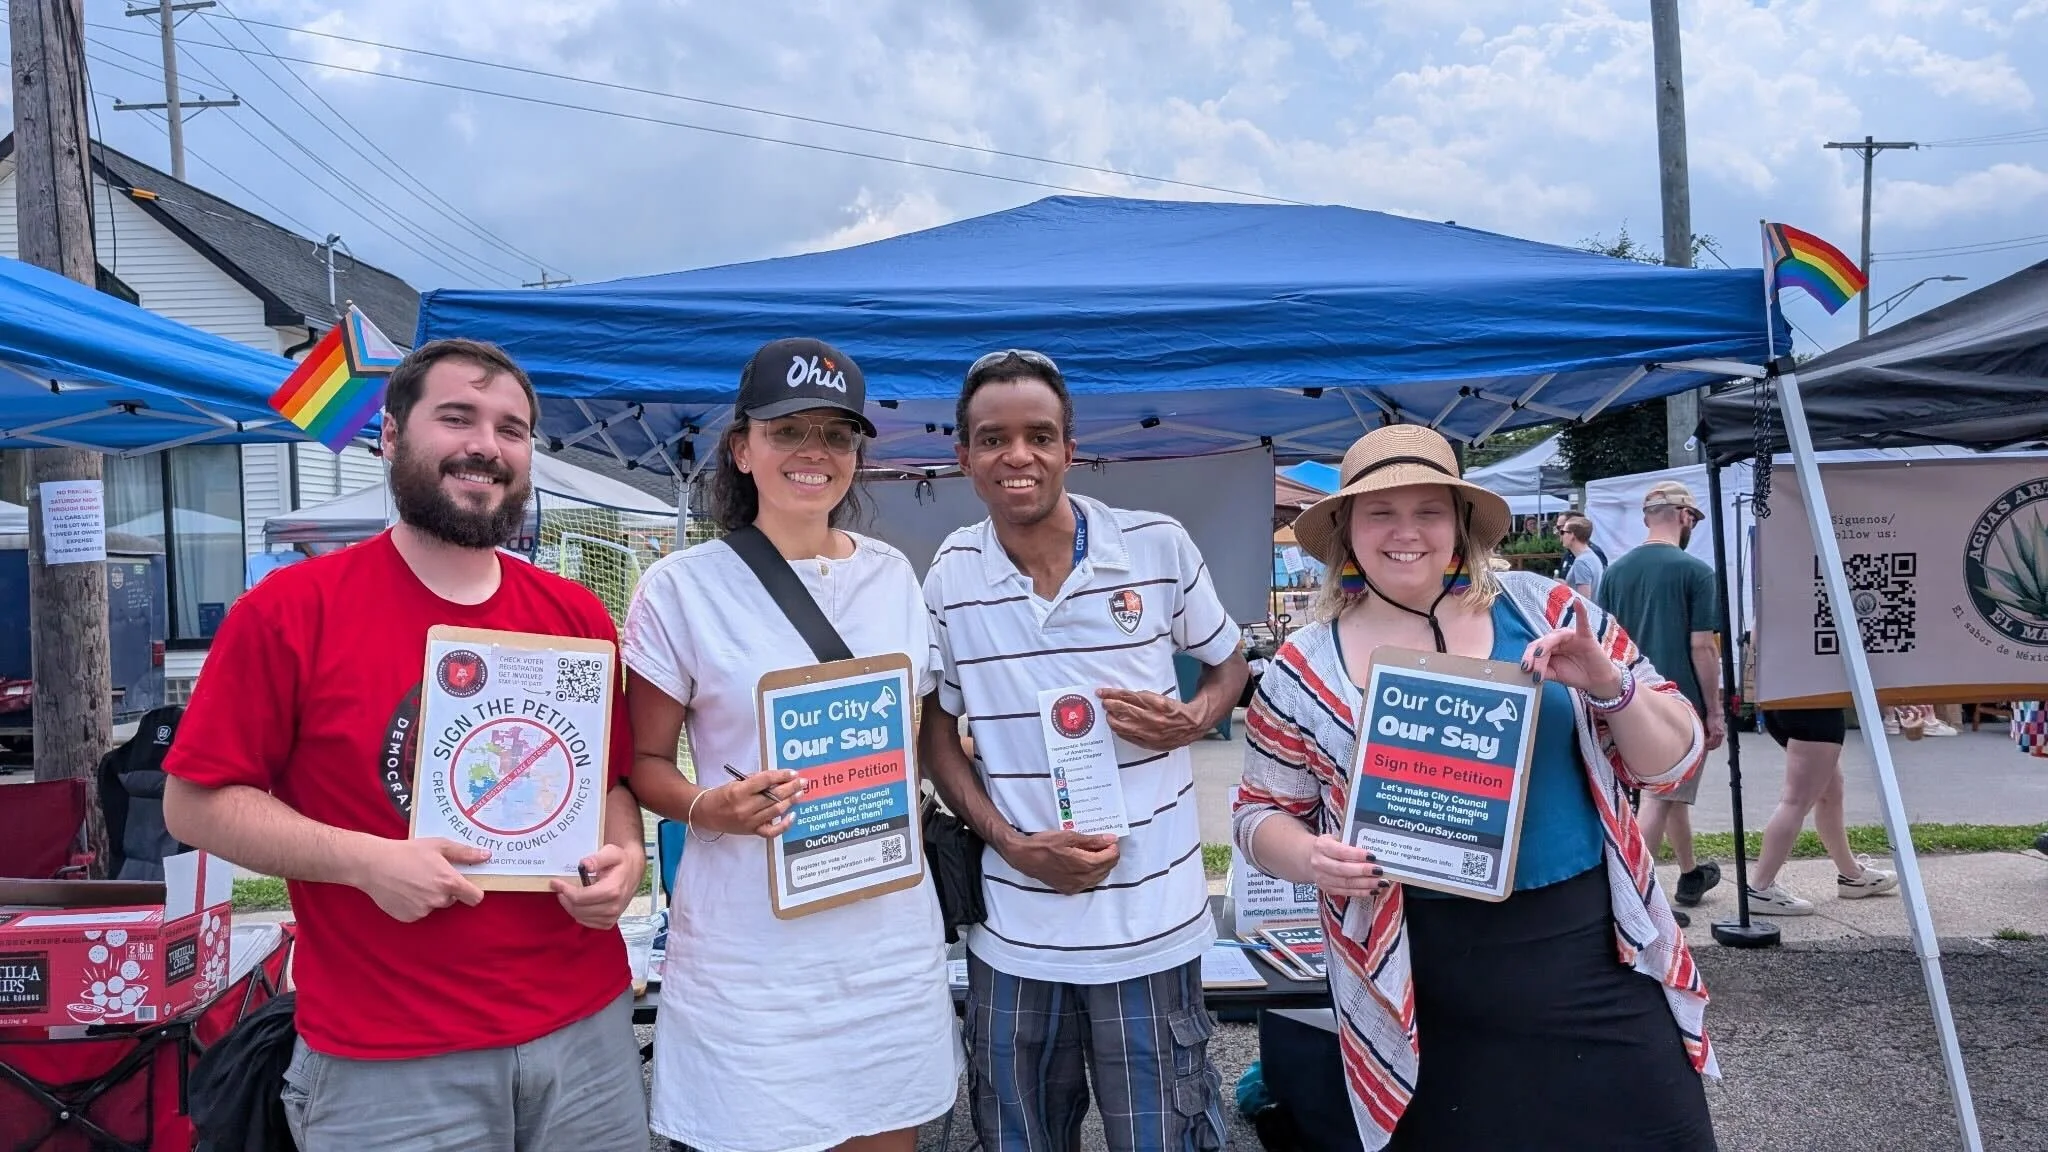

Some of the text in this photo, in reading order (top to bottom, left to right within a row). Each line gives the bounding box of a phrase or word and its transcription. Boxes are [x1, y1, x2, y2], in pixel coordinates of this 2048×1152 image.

[1835, 530, 1897, 540] ollow us:
[1969, 499, 2011, 564] AGUAS
[1952, 604, 1965, 619] El
[1964, 621, 1993, 646] sabor
[1996, 643, 2010, 656] de
[1989, 606, 2014, 633] EL
[498, 664, 544, 673] REGISTRATION
[499, 655, 521, 663] CHECK
[512, 673, 543, 681] INVOLVED
[780, 699, 870, 731] Our City
[1383, 686, 1485, 725] Our City
[433, 697, 592, 768] SIGN THE PETITION
[782, 725, 889, 761] Our Say
[1377, 715, 1500, 760] Our Say
[514, 763, 527, 776] FAKE
[823, 770, 844, 787] the
[848, 762, 898, 782] Petition
[1374, 753, 1503, 788] Sign the Petition
[472, 798, 486, 812] FAKE
[800, 787, 890, 815] Let's make City Council
[1375, 791, 1489, 820] accountable by changing
[1381, 782, 1488, 809] Let's make City Council
[432, 770, 591, 852] CREATE REAL CITY COUNCIL DISTRICTS
[797, 797, 894, 826] accountable by changing
[809, 822, 826, 832] how
[841, 814, 860, 825] elect
[861, 807, 883, 819] them!
[1387, 802, 1474, 826] how we elect them!
[805, 821, 890, 848] OurCityOurSay.com
[1378, 815, 1478, 843] OurCityOurSay.com
[1361, 843, 1384, 853] update
[1384, 848, 1399, 857] your
[1400, 850, 1438, 865] registration
[1362, 835, 1390, 847] Register
[1399, 843, 1413, 851] vote
[796, 862, 820, 872] Register
[828, 856, 840, 864] vote
[796, 871, 817, 881] update
[817, 867, 831, 877] your
[831, 859, 863, 872] registration
[1247, 879, 1264, 887] about
[1247, 888, 1272, 896] problem
[129, 945, 136, 954] 2
[138, 953, 154, 961] TOTAL
[140, 942, 154, 954] 6 LB
